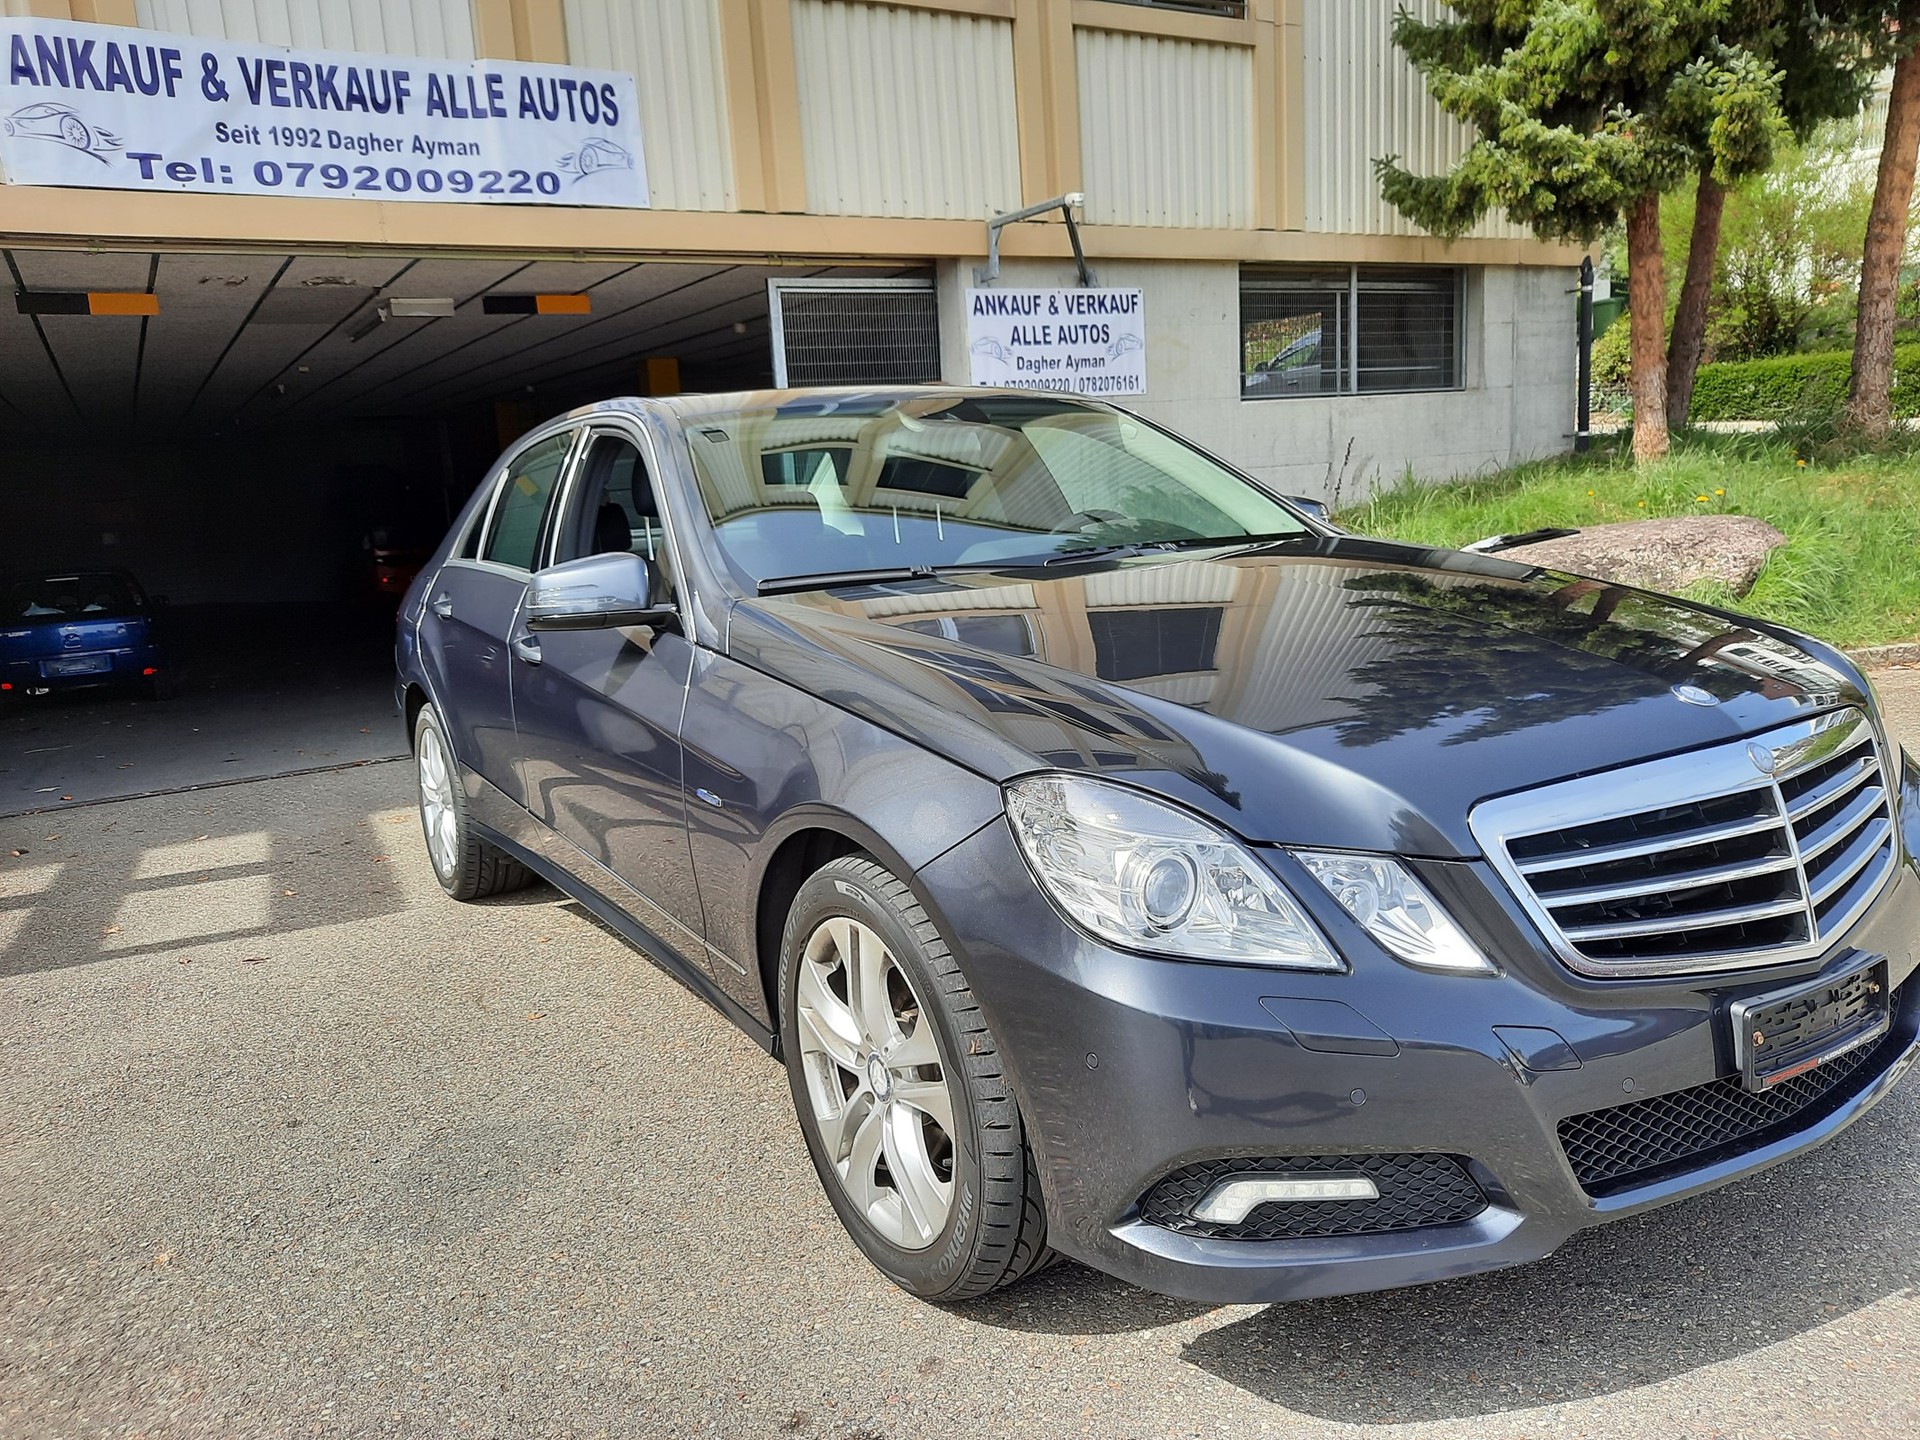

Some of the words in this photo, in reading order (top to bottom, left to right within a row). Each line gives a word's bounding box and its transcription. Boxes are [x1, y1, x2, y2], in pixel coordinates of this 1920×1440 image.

[10, 34, 183, 98] ANKAUF
[201, 52, 229, 102] &
[236, 56, 412, 114] VERKAUF
[427, 73, 507, 118] ALLE
[519, 76, 619, 127] AUTOS
[215, 121, 261, 146] Seit
[268, 125, 322, 148] 1992
[327, 129, 403, 156] Dagher
[412, 134, 481, 160] Ayman
[126, 152, 233, 183] Tel:
[252, 160, 560, 195] 0792009220
[973, 294, 1042, 316] ANKAUF
[1048, 294, 1060, 316] &
[1064, 293, 1138, 315] VERKAUF
[1010, 325, 1051, 346] ALLE
[1058, 324, 1110, 345] AUTOS
[1017, 355, 1061, 374] Dagher
[1065, 354, 1105, 373] Ayman
[1079, 374, 1139, 392] 0782076161
